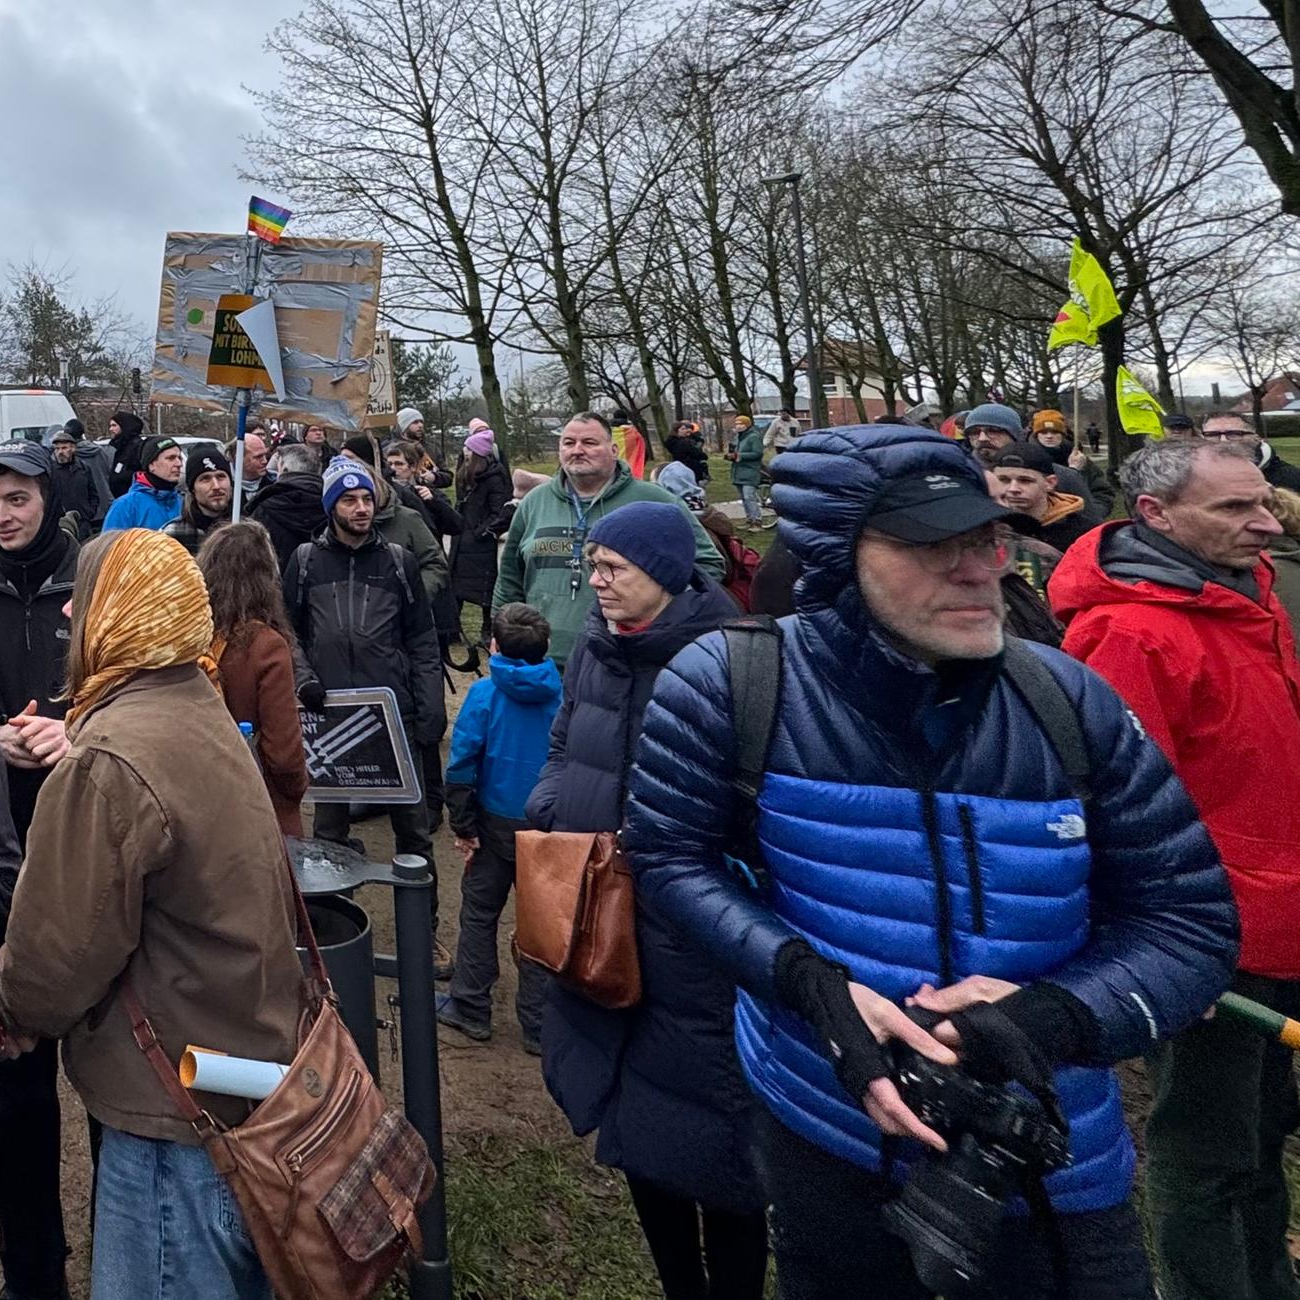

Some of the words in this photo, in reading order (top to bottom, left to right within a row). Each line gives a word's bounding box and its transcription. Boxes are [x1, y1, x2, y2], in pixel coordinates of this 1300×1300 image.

[214, 333, 231, 348] MIT
[231, 334, 254, 350] BIR
[230, 350, 264, 366] LOHM
[300, 711, 326, 723] RNE
[302, 722, 318, 734] NT
